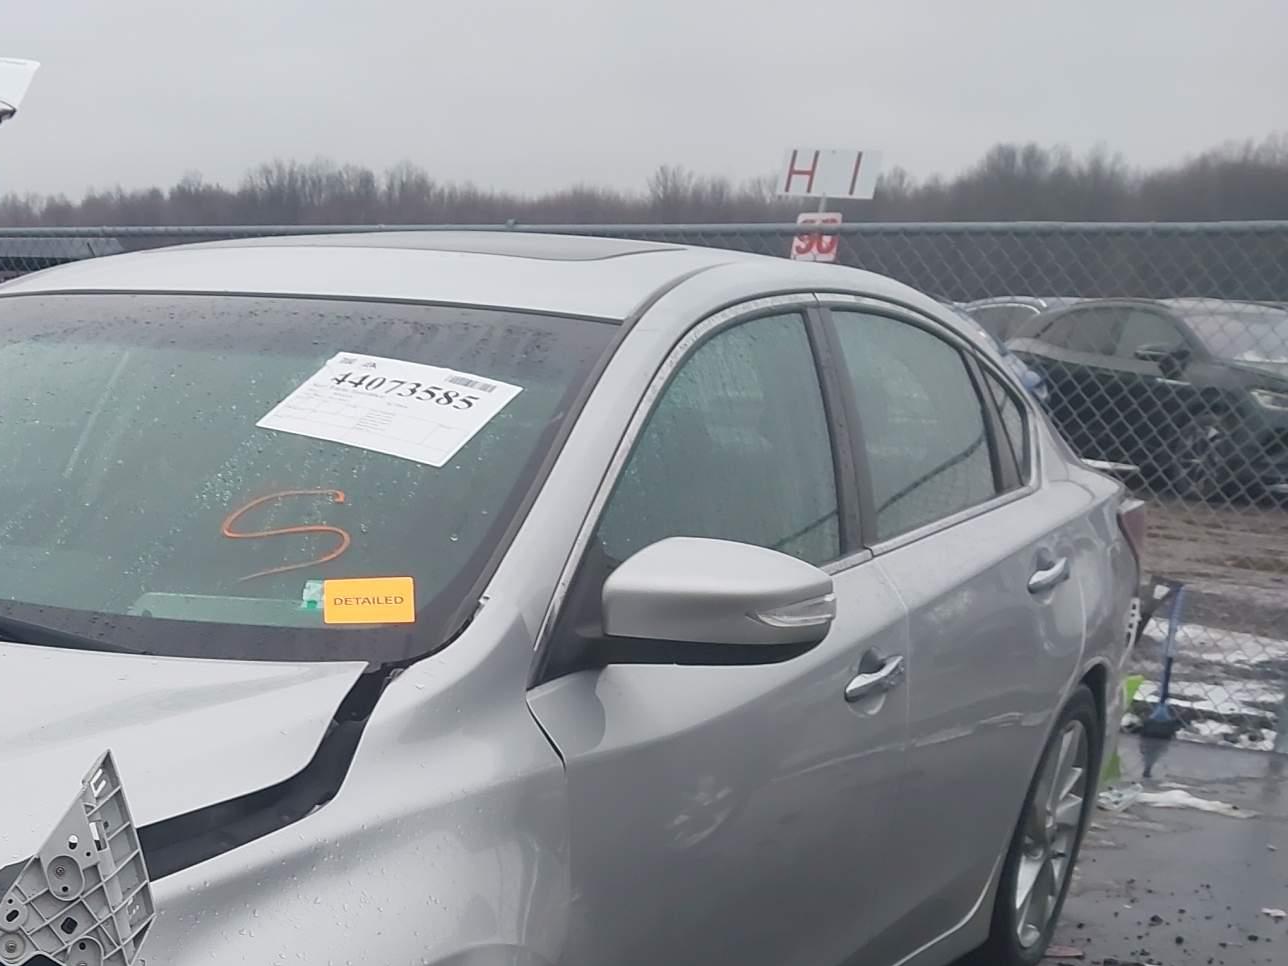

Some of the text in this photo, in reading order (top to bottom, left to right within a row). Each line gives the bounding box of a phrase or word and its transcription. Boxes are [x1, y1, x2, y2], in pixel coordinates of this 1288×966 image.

[330, 371, 480, 411] 44073585
[222, 490, 350, 582] S
[333, 594, 405, 608] DETAILED
